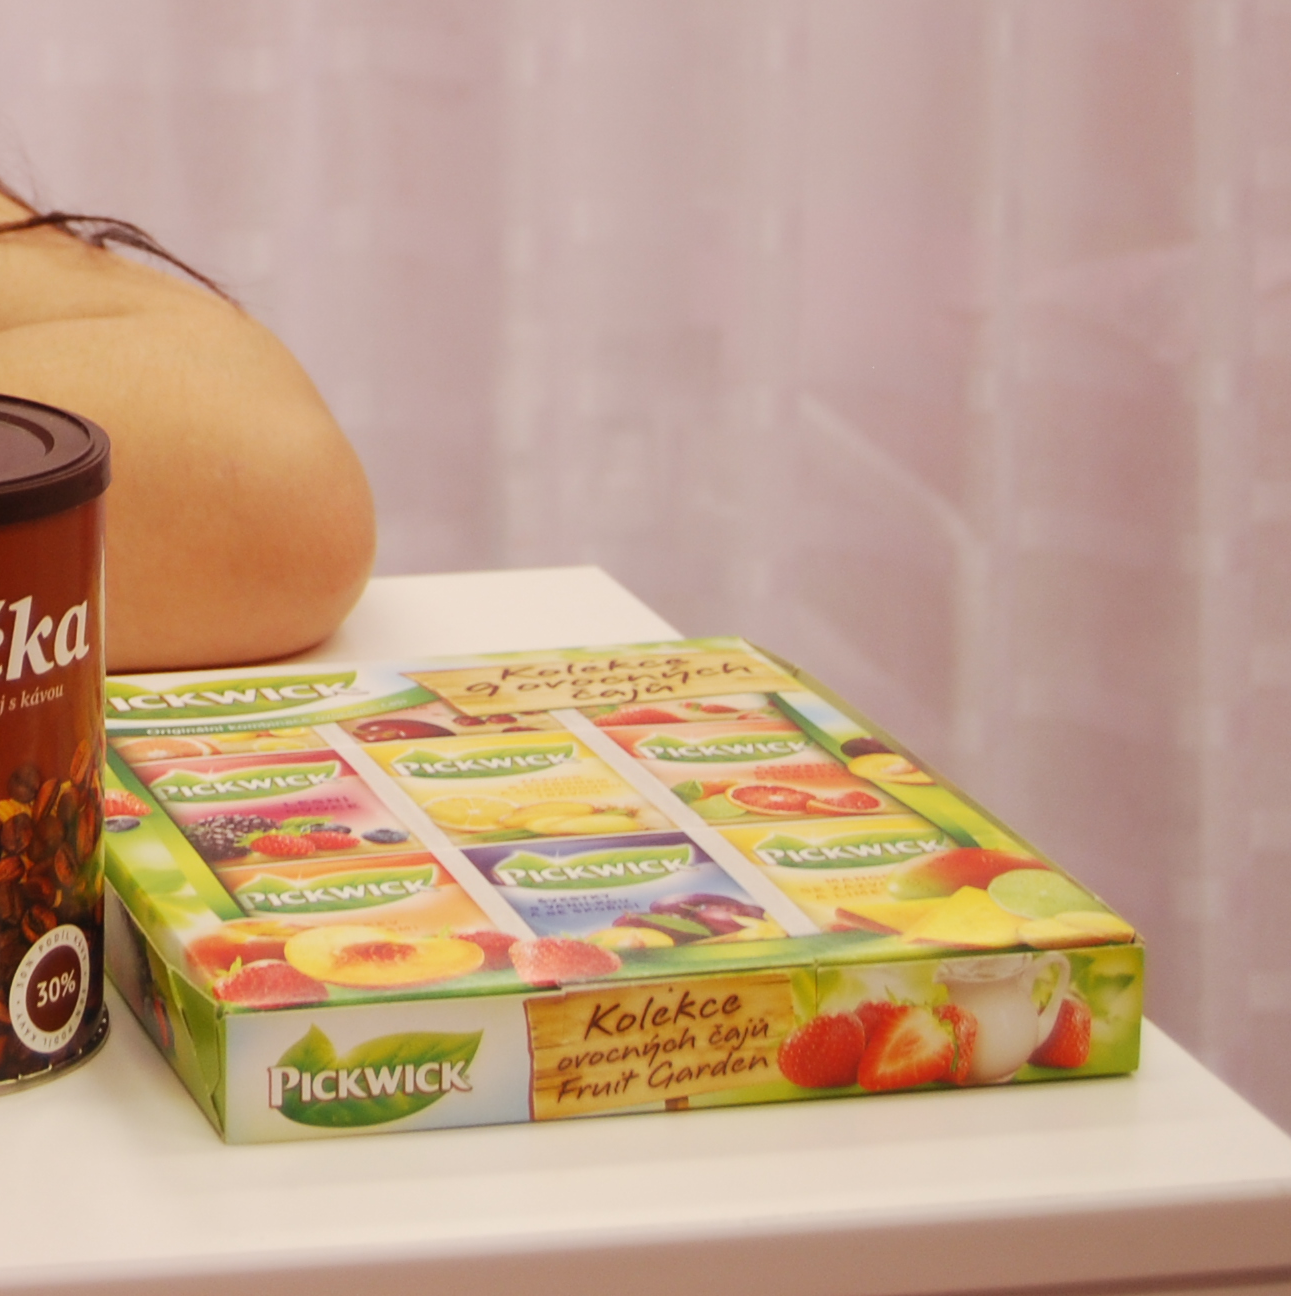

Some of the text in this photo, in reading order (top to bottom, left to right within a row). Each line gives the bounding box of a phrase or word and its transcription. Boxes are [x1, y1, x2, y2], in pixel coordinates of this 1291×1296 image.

[501, 658, 690, 680] Kolekce
[517, 661, 752, 691] ovocných
[8, 696, 17, 712] s
[19, 683, 64, 709] kávou
[107, 681, 350, 712] ICKWICK
[395, 748, 571, 779] PICKWICK
[639, 737, 811, 761] PICKWICK
[158, 770, 335, 801] PICKWICK
[757, 836, 946, 865] PICKWICK
[497, 856, 692, 887] PICKWICK
[241, 875, 431, 910] PICKWICK
[36, 968, 77, 1009] 30%
[583, 988, 743, 1040] Kolekce
[556, 1016, 772, 1074] ovocných čajů
[267, 1058, 474, 1109] PICKWICK
[554, 1049, 771, 1105] Fruit Garden
